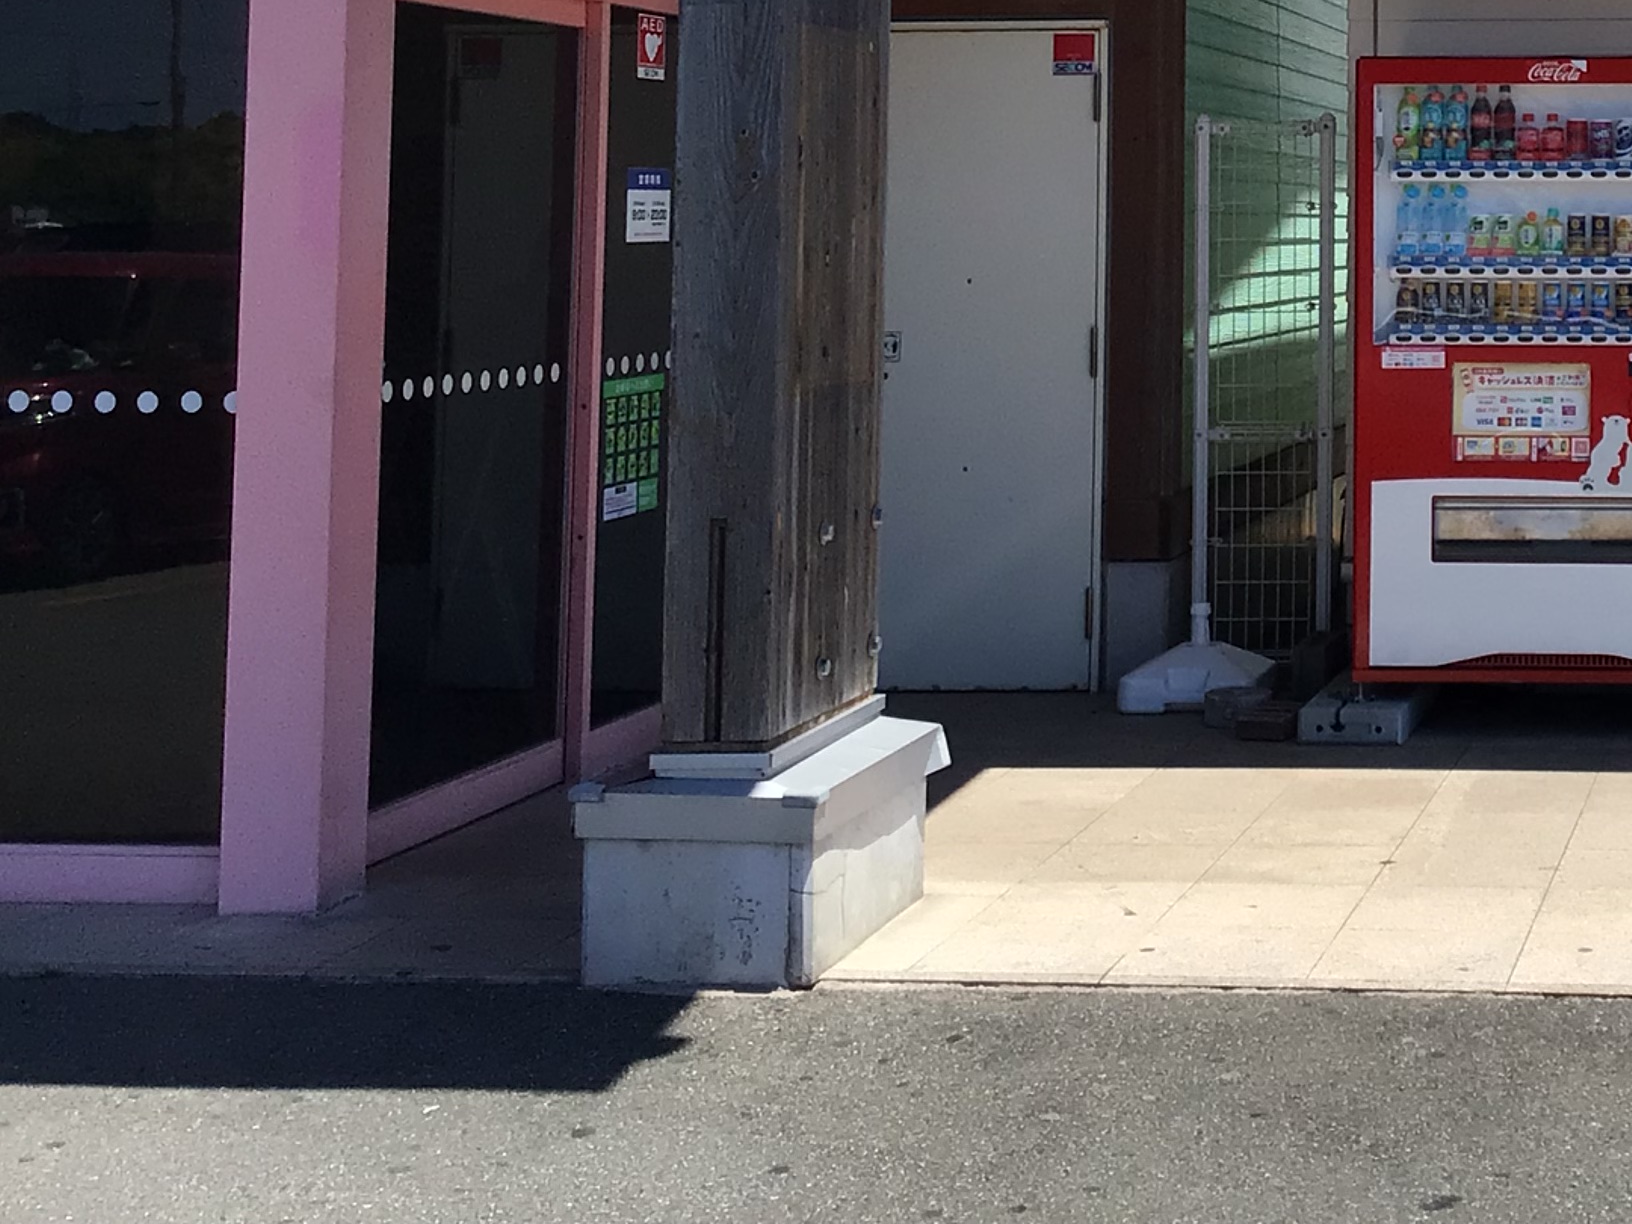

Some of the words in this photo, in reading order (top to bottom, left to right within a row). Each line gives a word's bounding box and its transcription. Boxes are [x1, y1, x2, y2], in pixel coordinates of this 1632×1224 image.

[641, 17, 663, 33] AED
[1527, 62, 1582, 82] Coca-Cola
[1476, 418, 1494, 426] VISA
